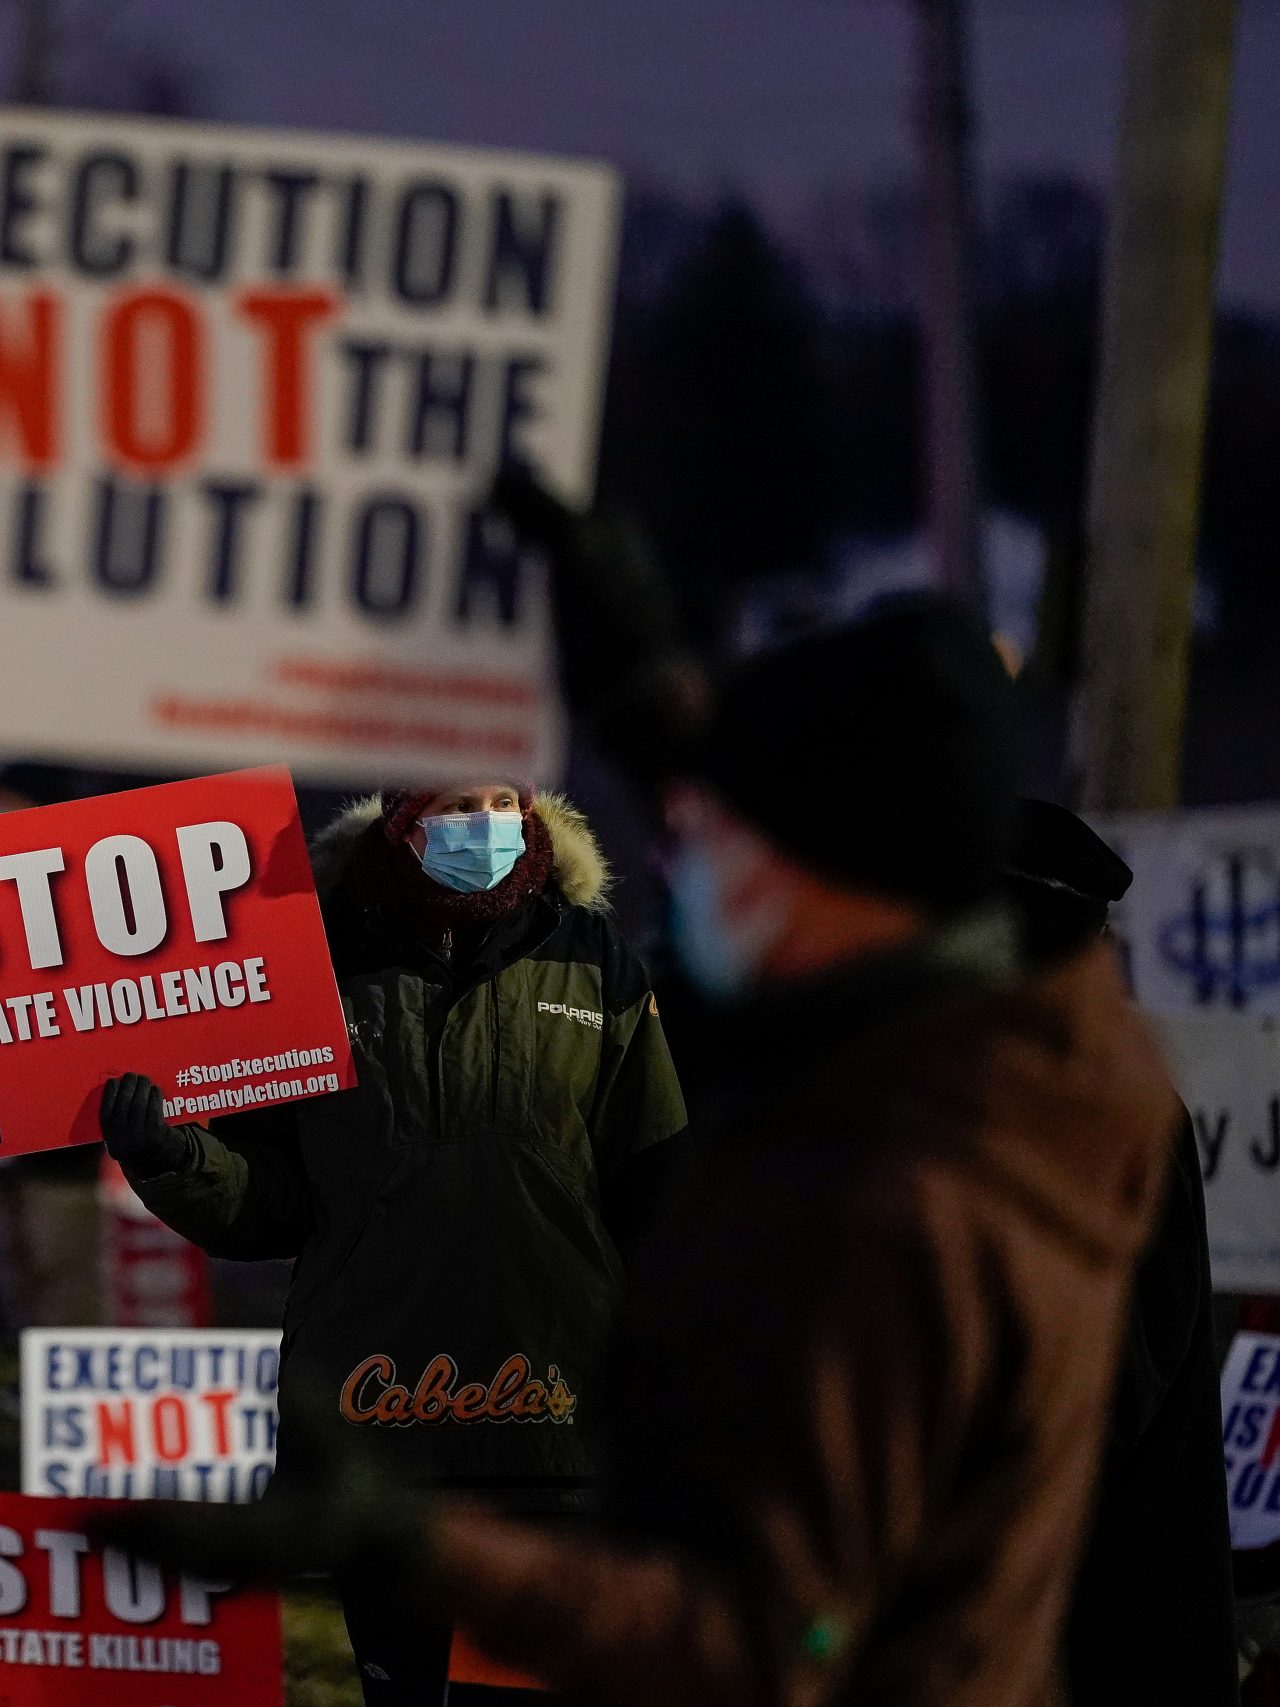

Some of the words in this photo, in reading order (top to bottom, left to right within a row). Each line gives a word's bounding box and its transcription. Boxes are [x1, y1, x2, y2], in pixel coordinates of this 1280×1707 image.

[338, 336, 546, 470] THE
[63, 957, 271, 1032] VIOLENCE
[537, 1001, 603, 1026] POLARIS
[176, 1046, 334, 1087] #StopExecutions
[163, 1073, 339, 1119] hPenaltyAction.org
[46, 1346, 280, 1394] EXECUTIO
[339, 1354, 576, 1427] Cabela's
[46, 1405, 86, 1449] IS
[96, 1390, 235, 1466] NOT
[1224, 1405, 1266, 1447] IS
[89, 1633, 221, 1675] KILLING
